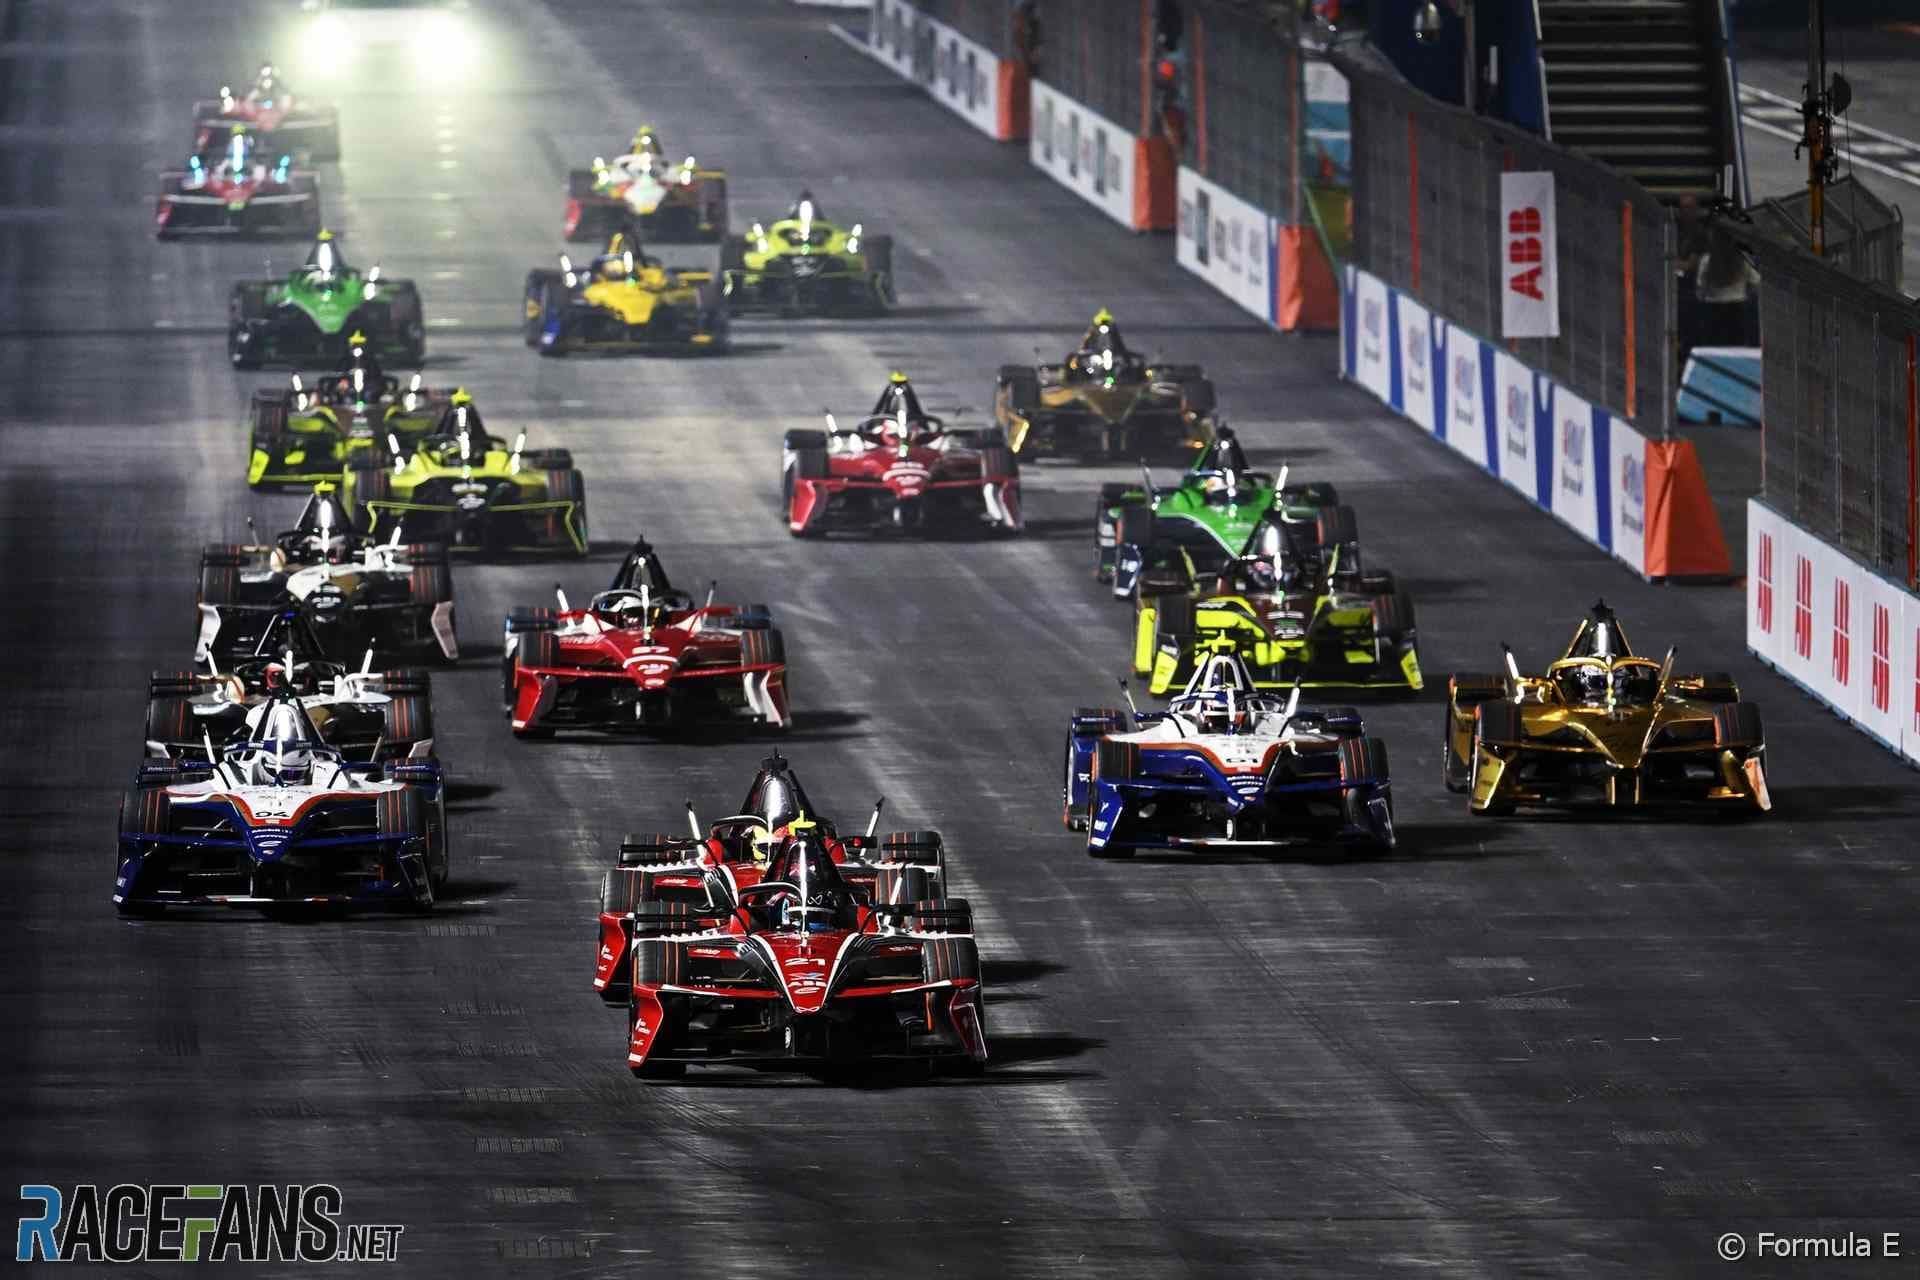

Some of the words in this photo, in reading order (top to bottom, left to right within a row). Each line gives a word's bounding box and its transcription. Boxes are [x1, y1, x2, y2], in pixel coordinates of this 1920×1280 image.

[1509, 207, 1544, 301] ABB
[1757, 530, 1773, 635] ABB
[1794, 554, 1813, 661] ABB
[1832, 576, 1850, 687] ABB
[1871, 602, 1890, 714] ABB
